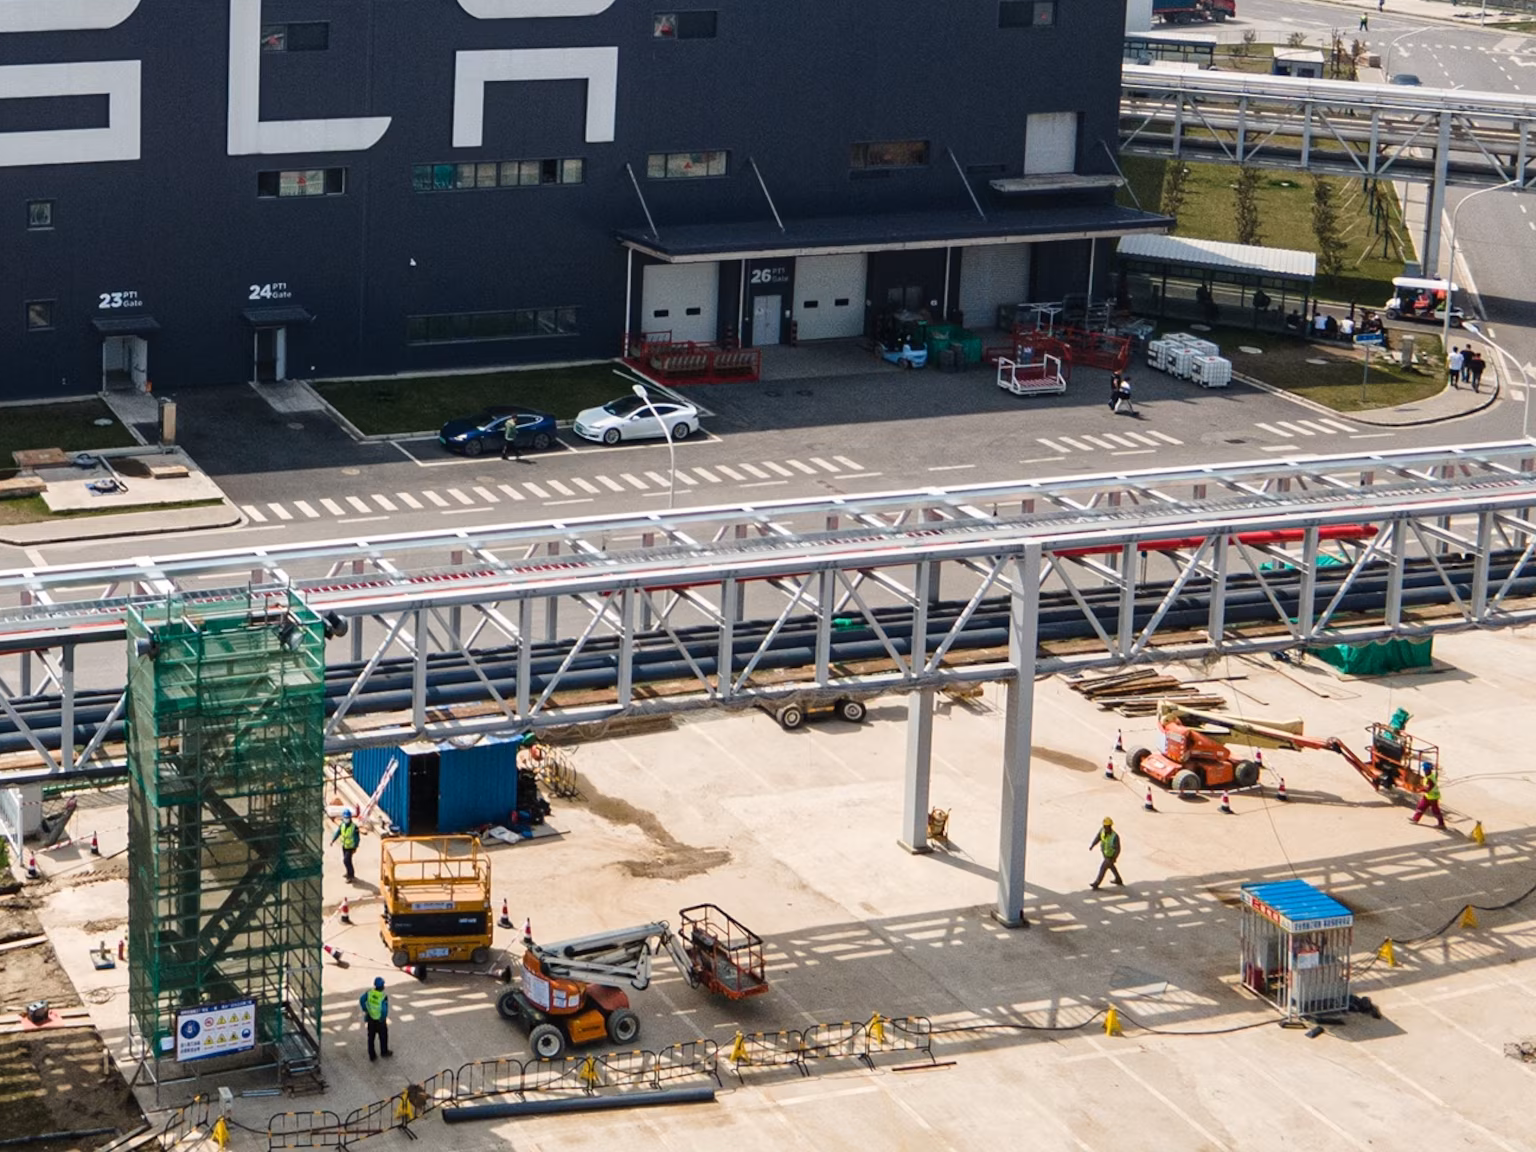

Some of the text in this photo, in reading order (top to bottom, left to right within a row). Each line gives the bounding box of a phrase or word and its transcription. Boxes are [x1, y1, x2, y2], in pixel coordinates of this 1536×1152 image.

[750, 268, 772, 284] 26
[272, 282, 287, 290] PT1
[122, 291, 138, 299] PT1
[249, 284, 273, 300] 24
[272, 291, 292, 299] Gate
[98, 292, 122, 309] 23
[122, 300, 143, 308] Gate
